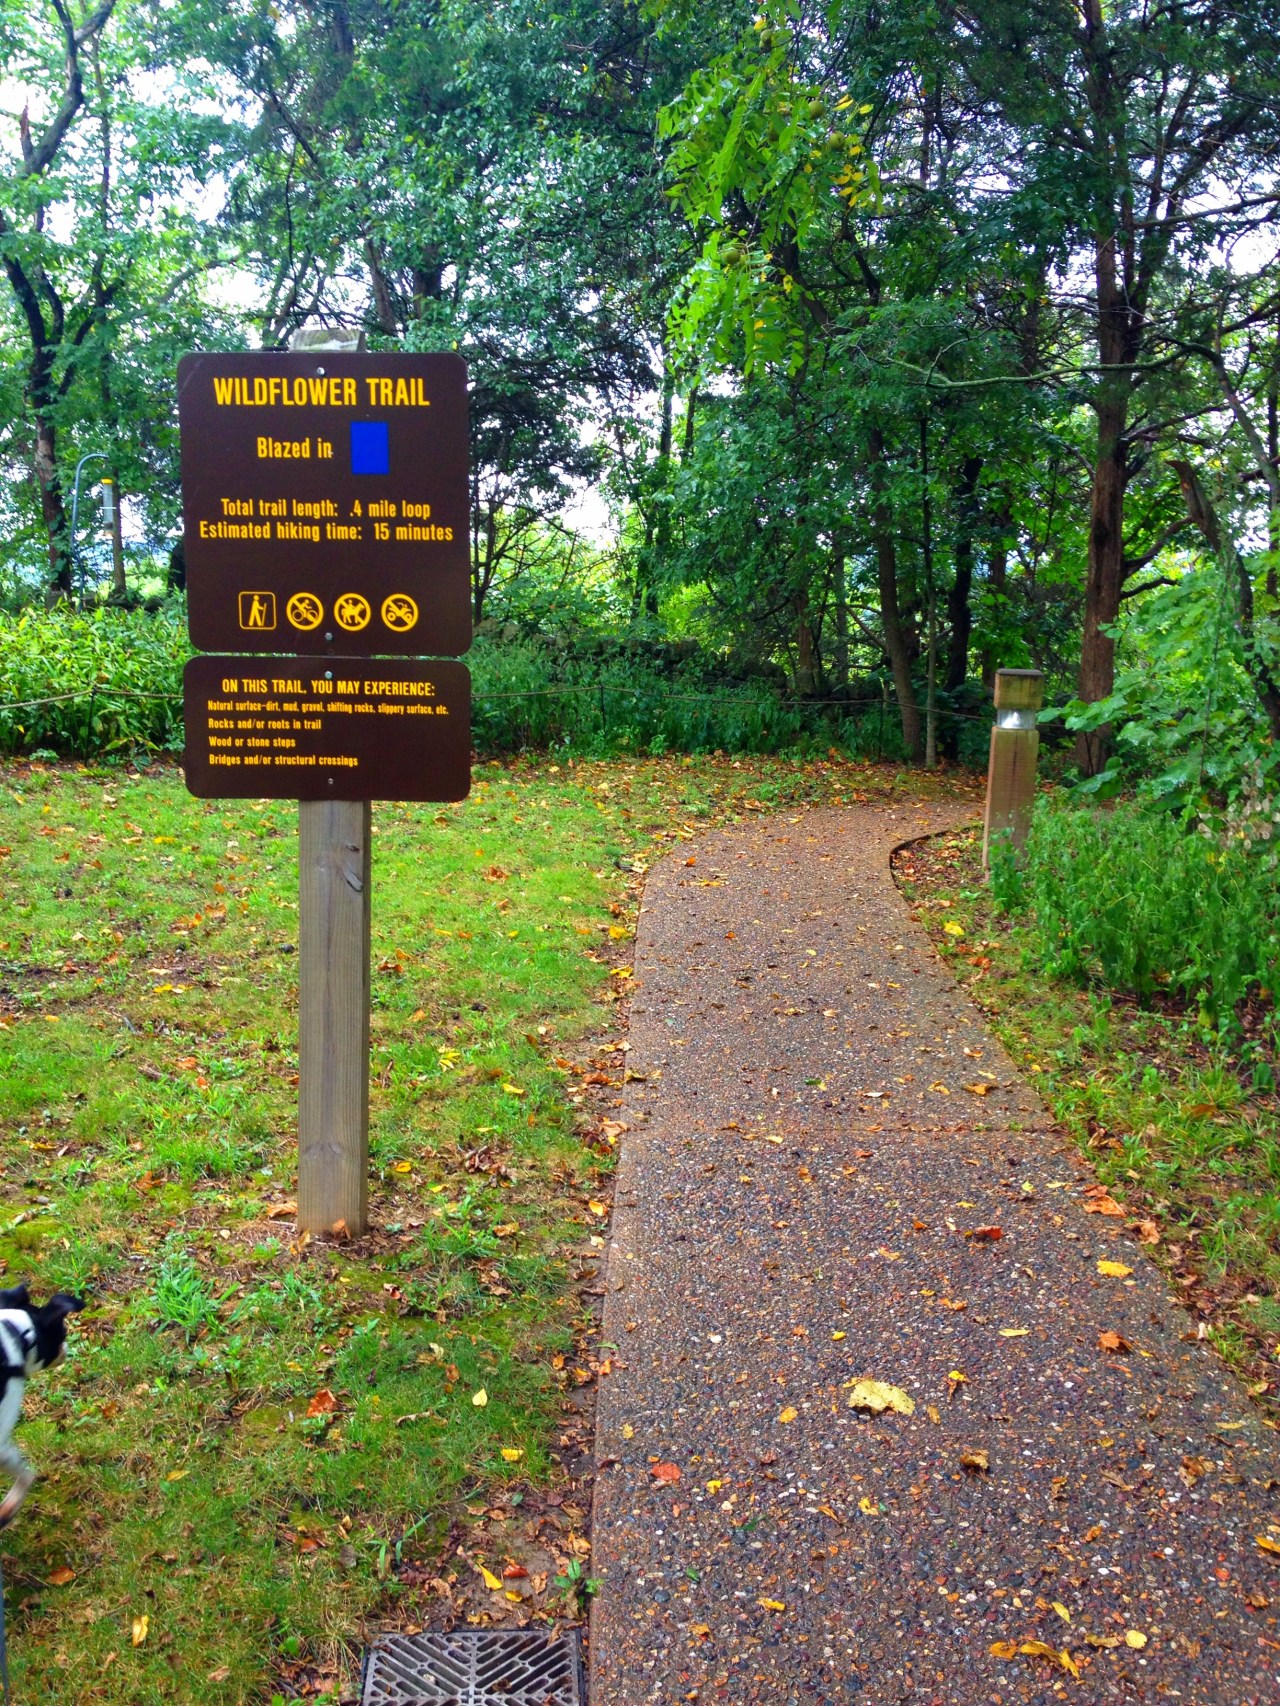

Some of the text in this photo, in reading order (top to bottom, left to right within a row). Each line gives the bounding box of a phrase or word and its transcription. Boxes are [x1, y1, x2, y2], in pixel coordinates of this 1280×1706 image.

[213, 377, 430, 406] WILDFLOWER TRAIL
[257, 437, 333, 458] Blazed in
[221, 498, 430, 520] Total trail length: .4 mile loop
[200, 521, 453, 542] Estimated hiking time: 15 minutes
[222, 679, 435, 696] ON THIS TRAIL, YOU MAY EXPERIENCE:
[208, 700, 233, 711] Natural
[302, 702, 325, 713] gravel,
[327, 702, 352, 714] shifting
[355, 703, 376, 713] rocks,
[378, 703, 404, 715] slippery
[407, 704, 434, 715] surface,
[436, 705, 449, 714] etc.
[208, 718, 322, 730] Rocks and/or roots in trail
[209, 736, 296, 749] Wood or stone steps
[209, 754, 358, 767] Bridges and/or structural crossings
